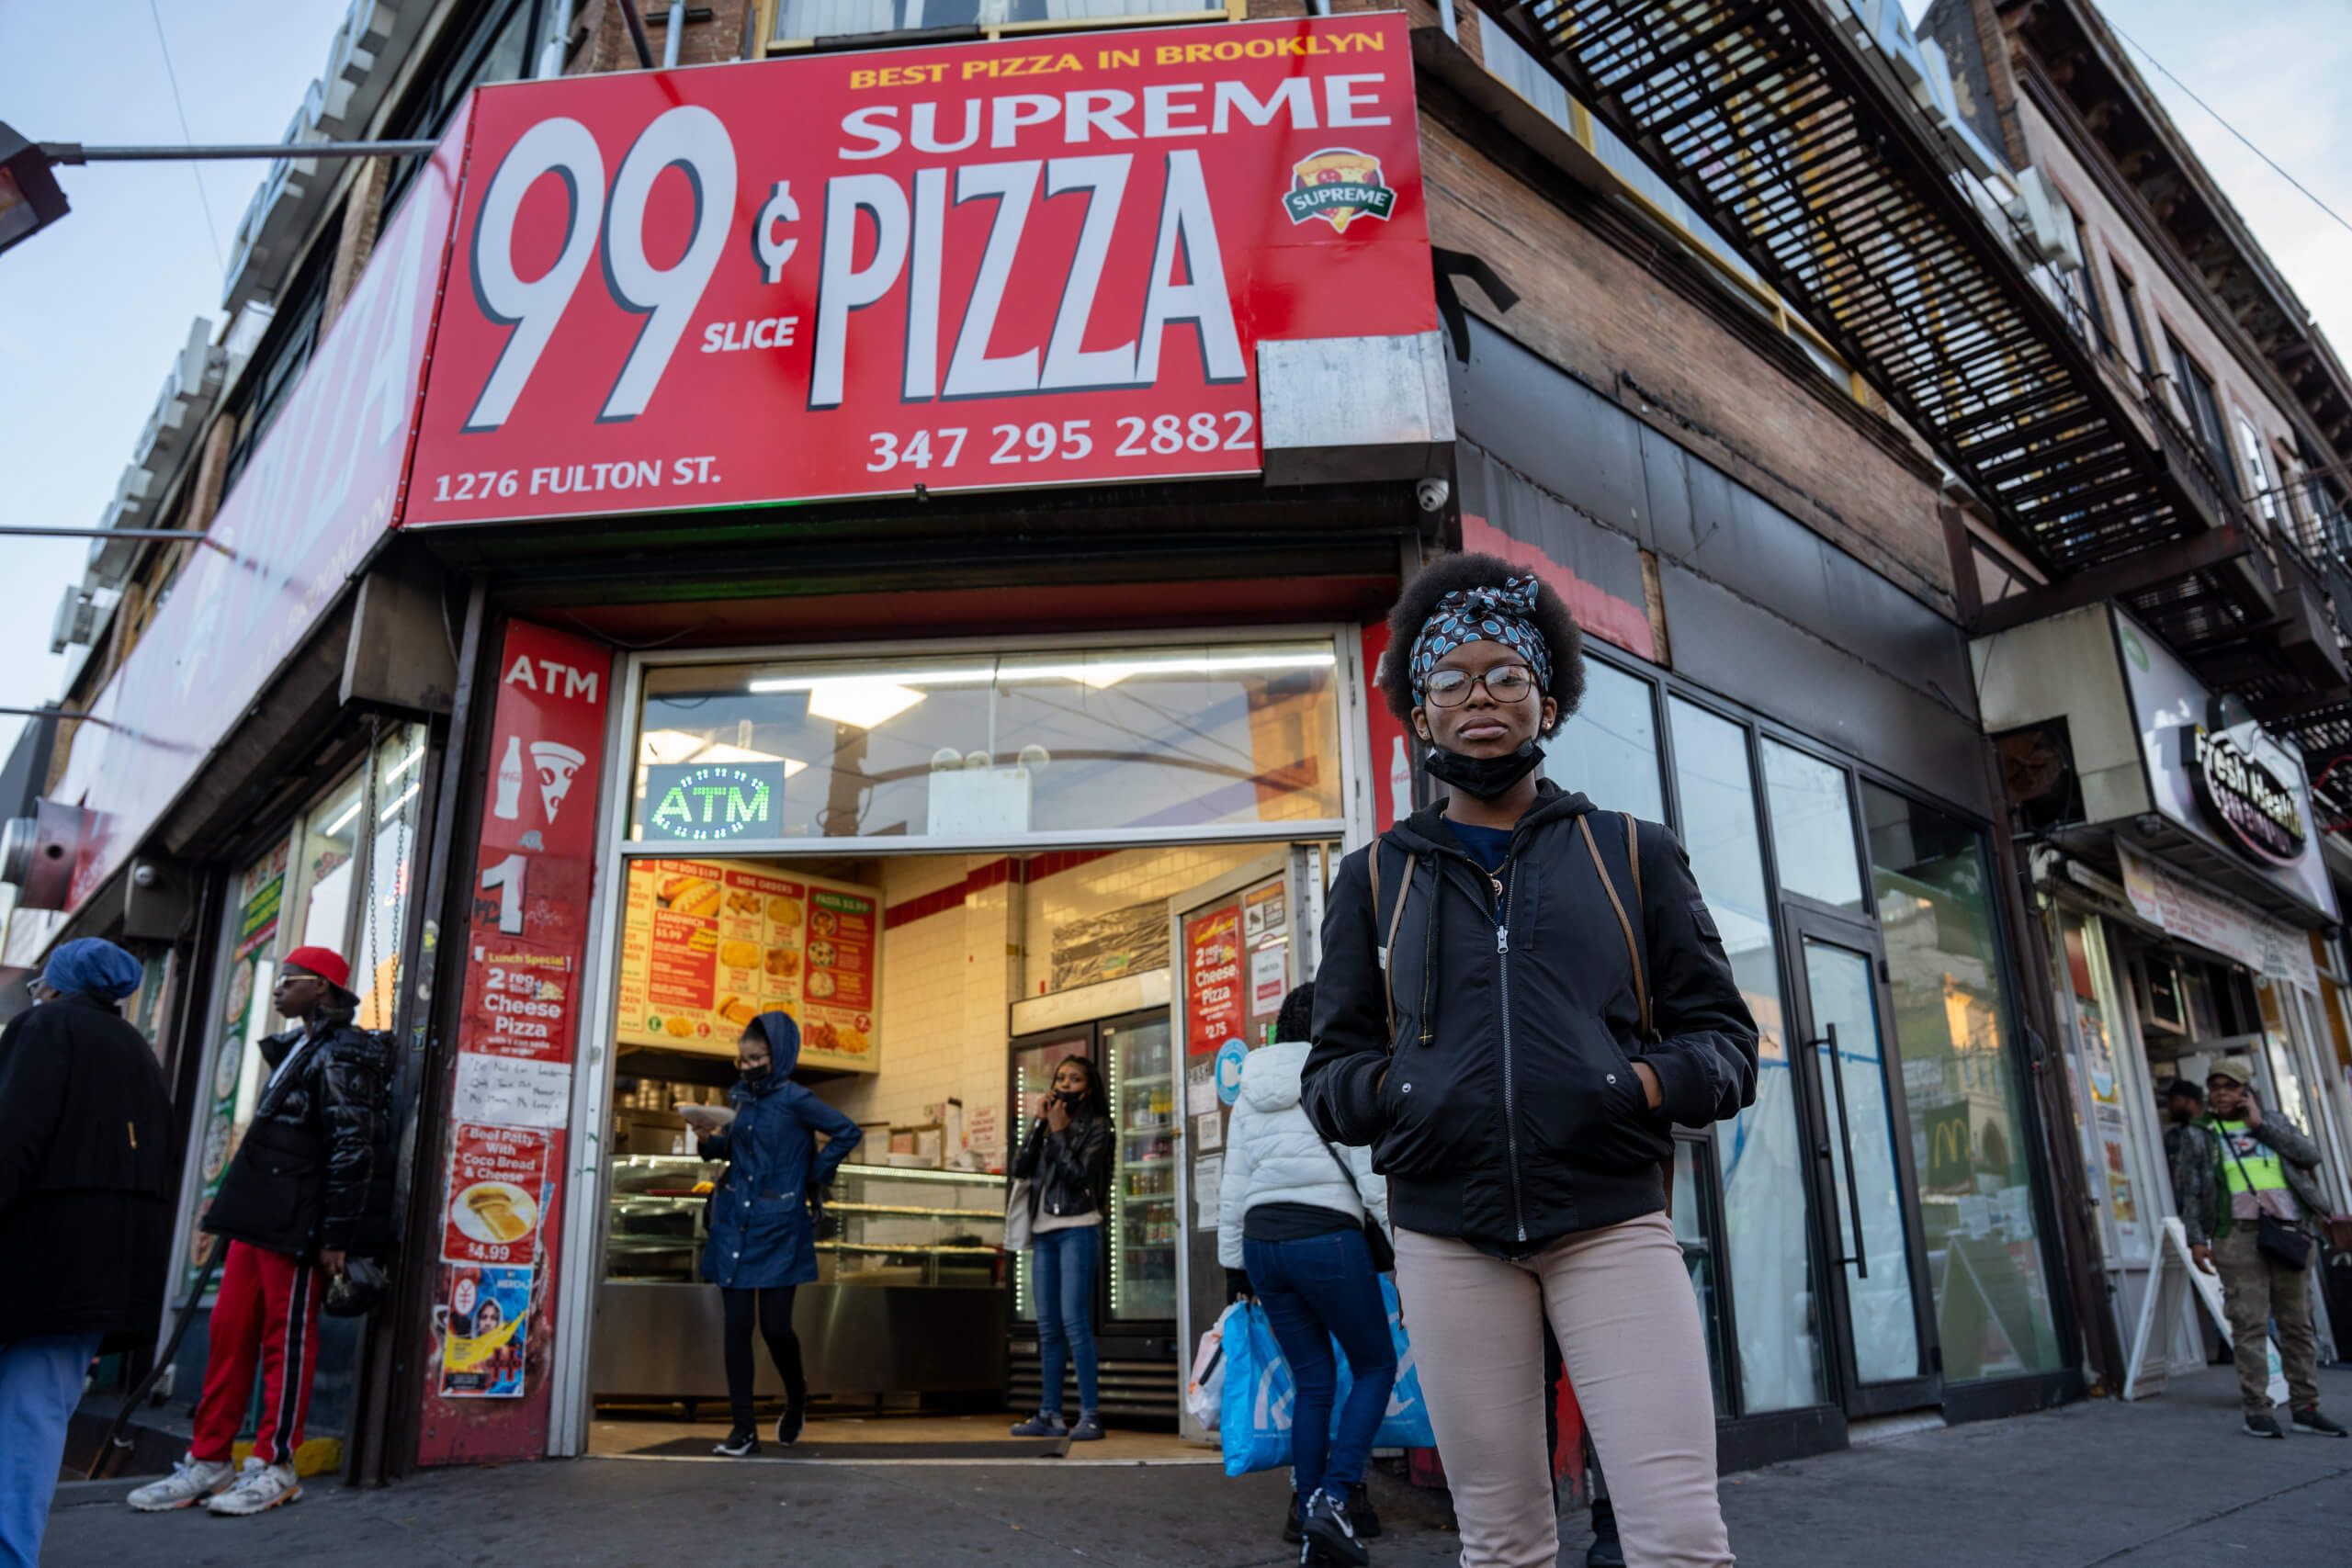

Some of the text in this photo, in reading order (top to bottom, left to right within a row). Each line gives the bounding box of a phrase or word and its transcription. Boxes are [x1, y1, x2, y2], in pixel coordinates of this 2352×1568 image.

[850, 31, 1385, 90] BEST PIZZA IN BROOKLYN
[838, 73, 1392, 161] SUPREME
[1291, 185, 1388, 211] SUPREME
[806, 149, 1247, 413] PIZZA
[701, 316, 798, 354] SLICE
[866, 411, 1256, 474] 347 295 2882
[433, 457, 721, 502] 1276 FULTON ST.
[504, 654, 599, 705] ATM
[651, 785, 770, 823] ATM
[488, 953, 564, 967] Lunch Special
[1195, 948, 1204, 967] 2
[486, 967, 505, 989] 2
[1195, 964, 1237, 987] Cheese
[484, 994, 561, 1019] Cheese
[1202, 986, 1230, 1005] Pizza
[494, 1016, 548, 1038] Pizza
[485, 1142, 516, 1156] With
[462, 1153, 536, 1171] Coco Bread
[477, 1168, 525, 1183] Cheese
